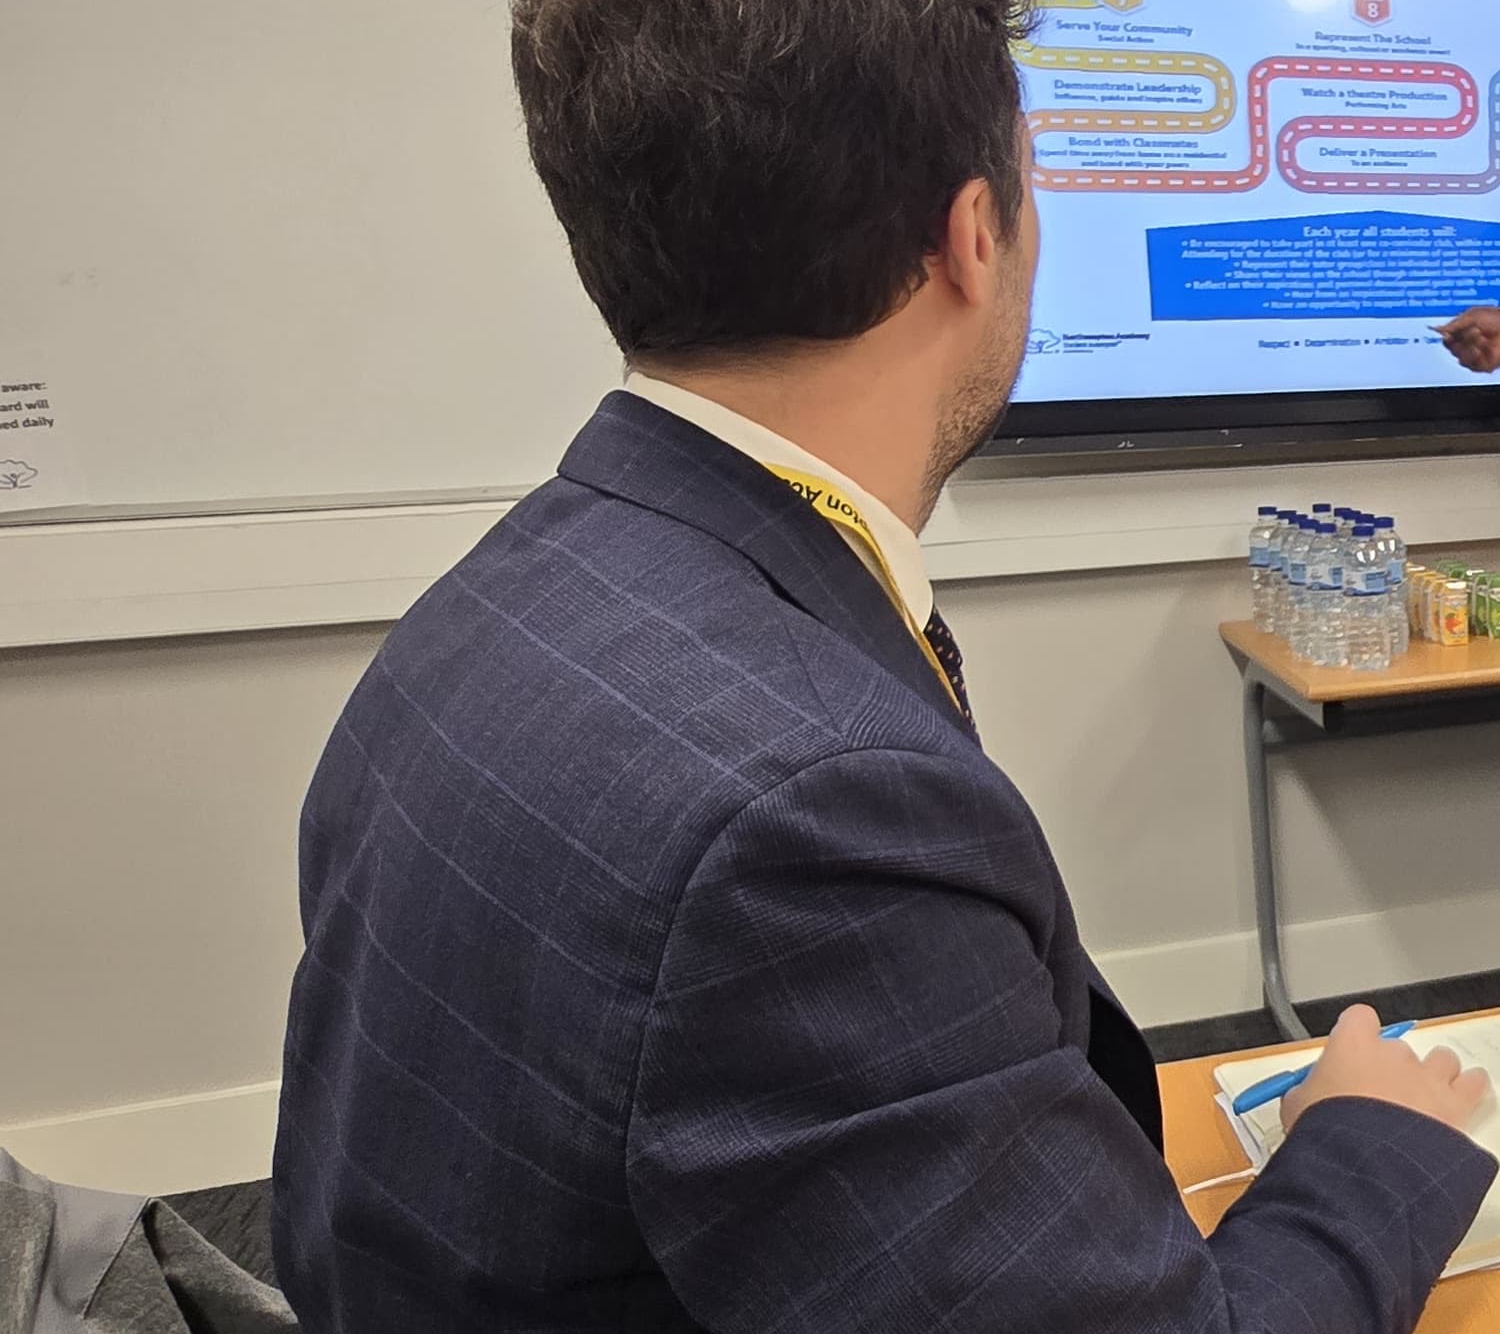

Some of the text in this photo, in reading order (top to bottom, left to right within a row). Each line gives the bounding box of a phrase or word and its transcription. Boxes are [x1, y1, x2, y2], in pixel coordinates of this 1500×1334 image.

[1367, 2, 1379, 18] 8
[1056, 19, 1193, 37] Serve Your Community
[1054, 79, 1202, 95] Demonstrate Leadership
[1068, 136, 1101, 147] Bond
[1103, 137, 1130, 147] with
[1303, 227, 1331, 236] Each
[1334, 228, 1360, 238] year
[1363, 227, 1377, 236] all
[1381, 227, 1430, 236] students
[25, 399, 49, 410] will
[22, 417, 54, 429] daily
